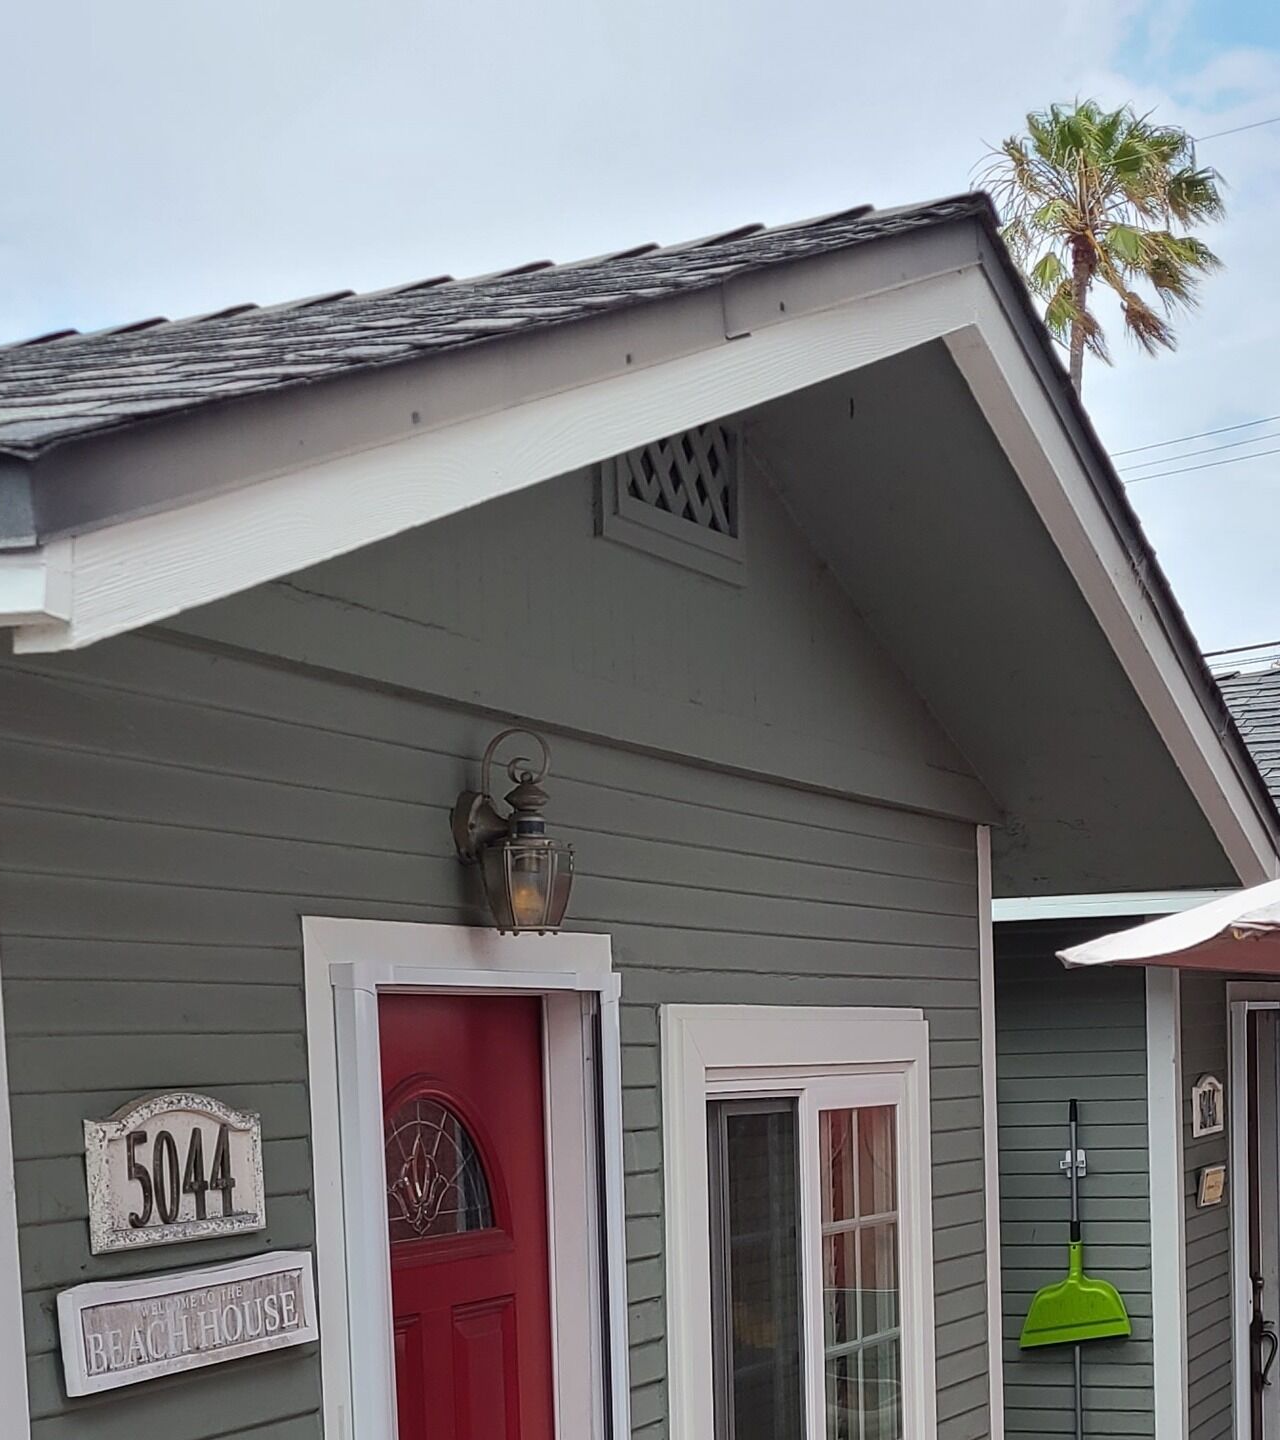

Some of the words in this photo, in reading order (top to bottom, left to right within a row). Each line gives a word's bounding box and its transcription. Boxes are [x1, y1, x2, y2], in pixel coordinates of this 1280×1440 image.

[126, 1124, 236, 1228] 5044
[86, 1313, 192, 1373] BEACH
[197, 1290, 299, 1348] HOUSE
[140, 1295, 197, 1317] WELCOME
[200, 1291, 215, 1305] TO
[221, 1286, 243, 1300] THE
